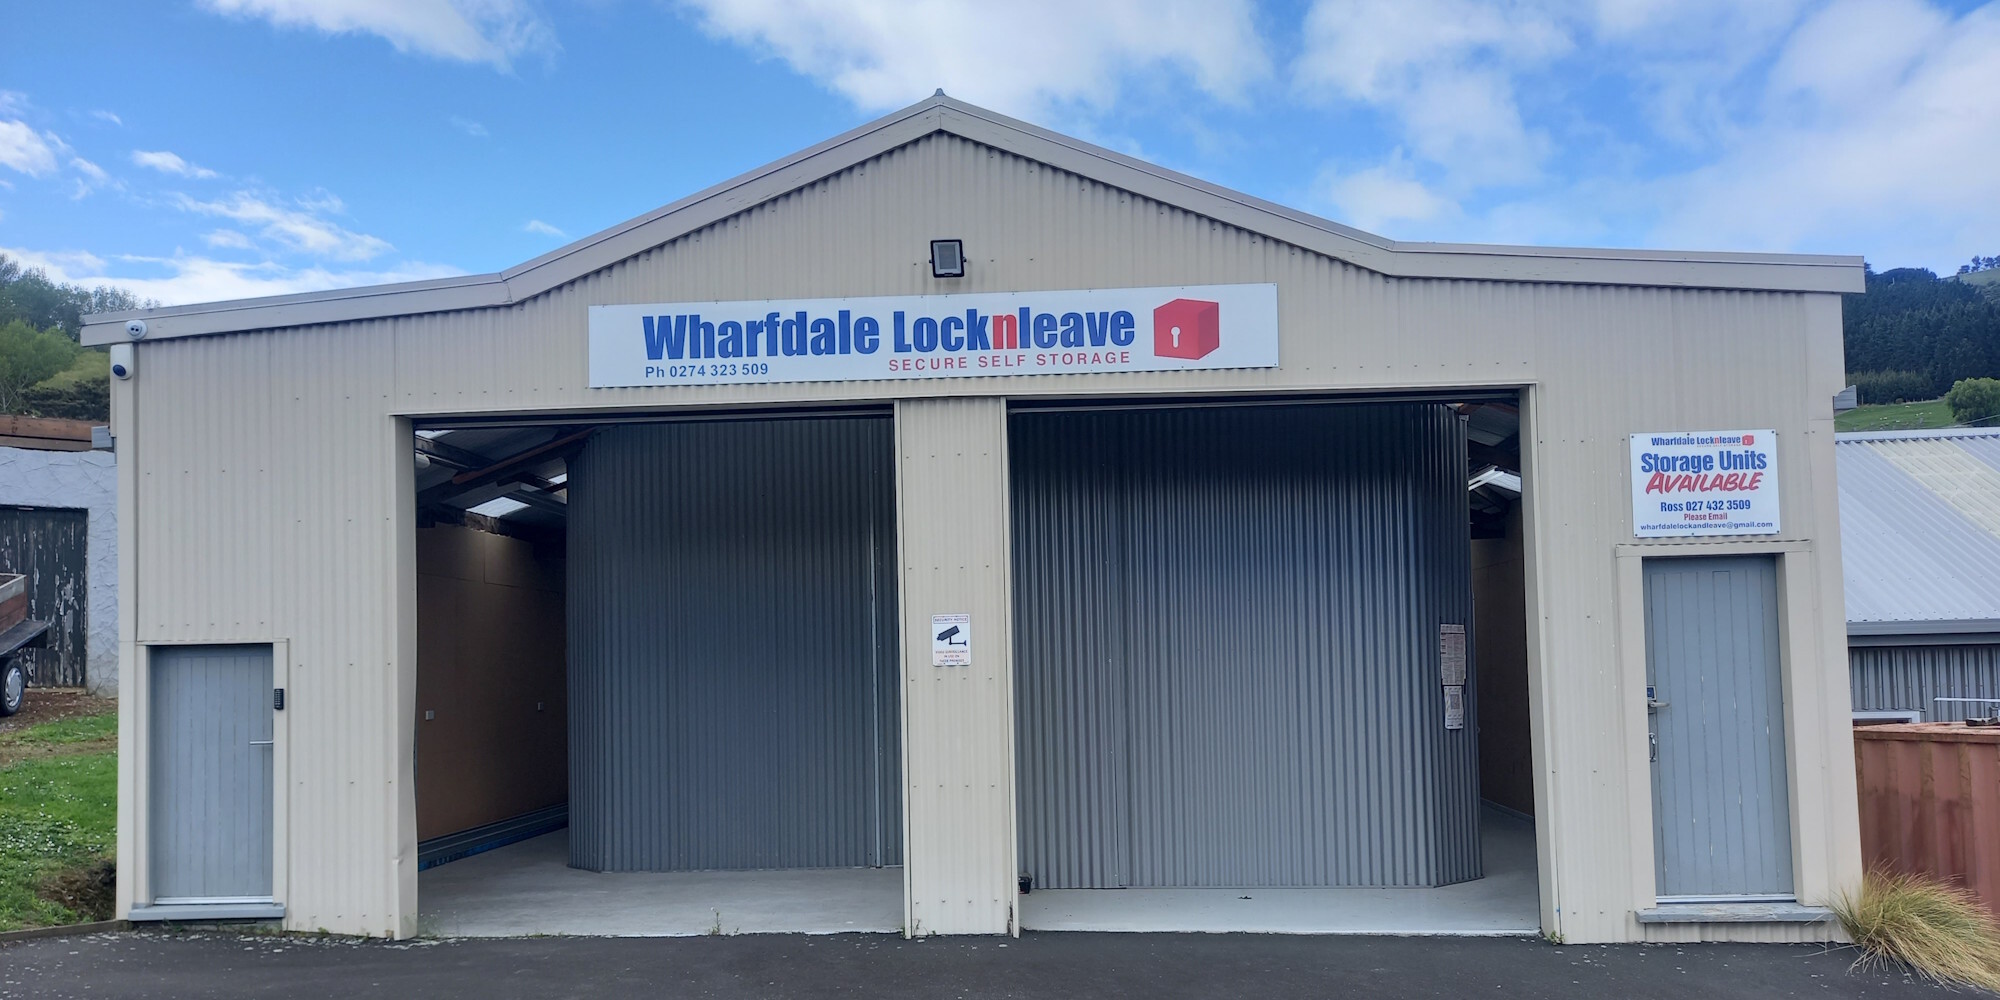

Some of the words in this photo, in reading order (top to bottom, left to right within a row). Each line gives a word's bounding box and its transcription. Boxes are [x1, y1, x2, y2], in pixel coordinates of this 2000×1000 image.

[642, 310, 880, 360] Wharfdale
[893, 307, 1135, 353] Locknleave
[889, 356, 968, 372] SECURE
[978, 354, 1026, 368] SELF
[1036, 351, 1131, 367] STORAGE
[645, 366, 665, 378] Ph
[669, 365, 706, 378] 0274
[710, 364, 737, 377] 323
[741, 363, 769, 376] 509
[1651, 436, 1695, 446] Wharfdale
[1696, 435, 1741, 445] Locknleave
[1641, 453, 1714, 474] Storage
[1719, 450, 1767, 470] Units
[1645, 471, 1764, 494] AVAILABLE
[1660, 502, 1683, 512] Ross
[1685, 501, 1704, 511] 027
[1706, 500, 1724, 510] 432
[1726, 500, 1751, 510] 3509
[1708, 512, 1728, 520] Email
[1640, 521, 1773, 530] wharfdalelockandleave@gmail.com
